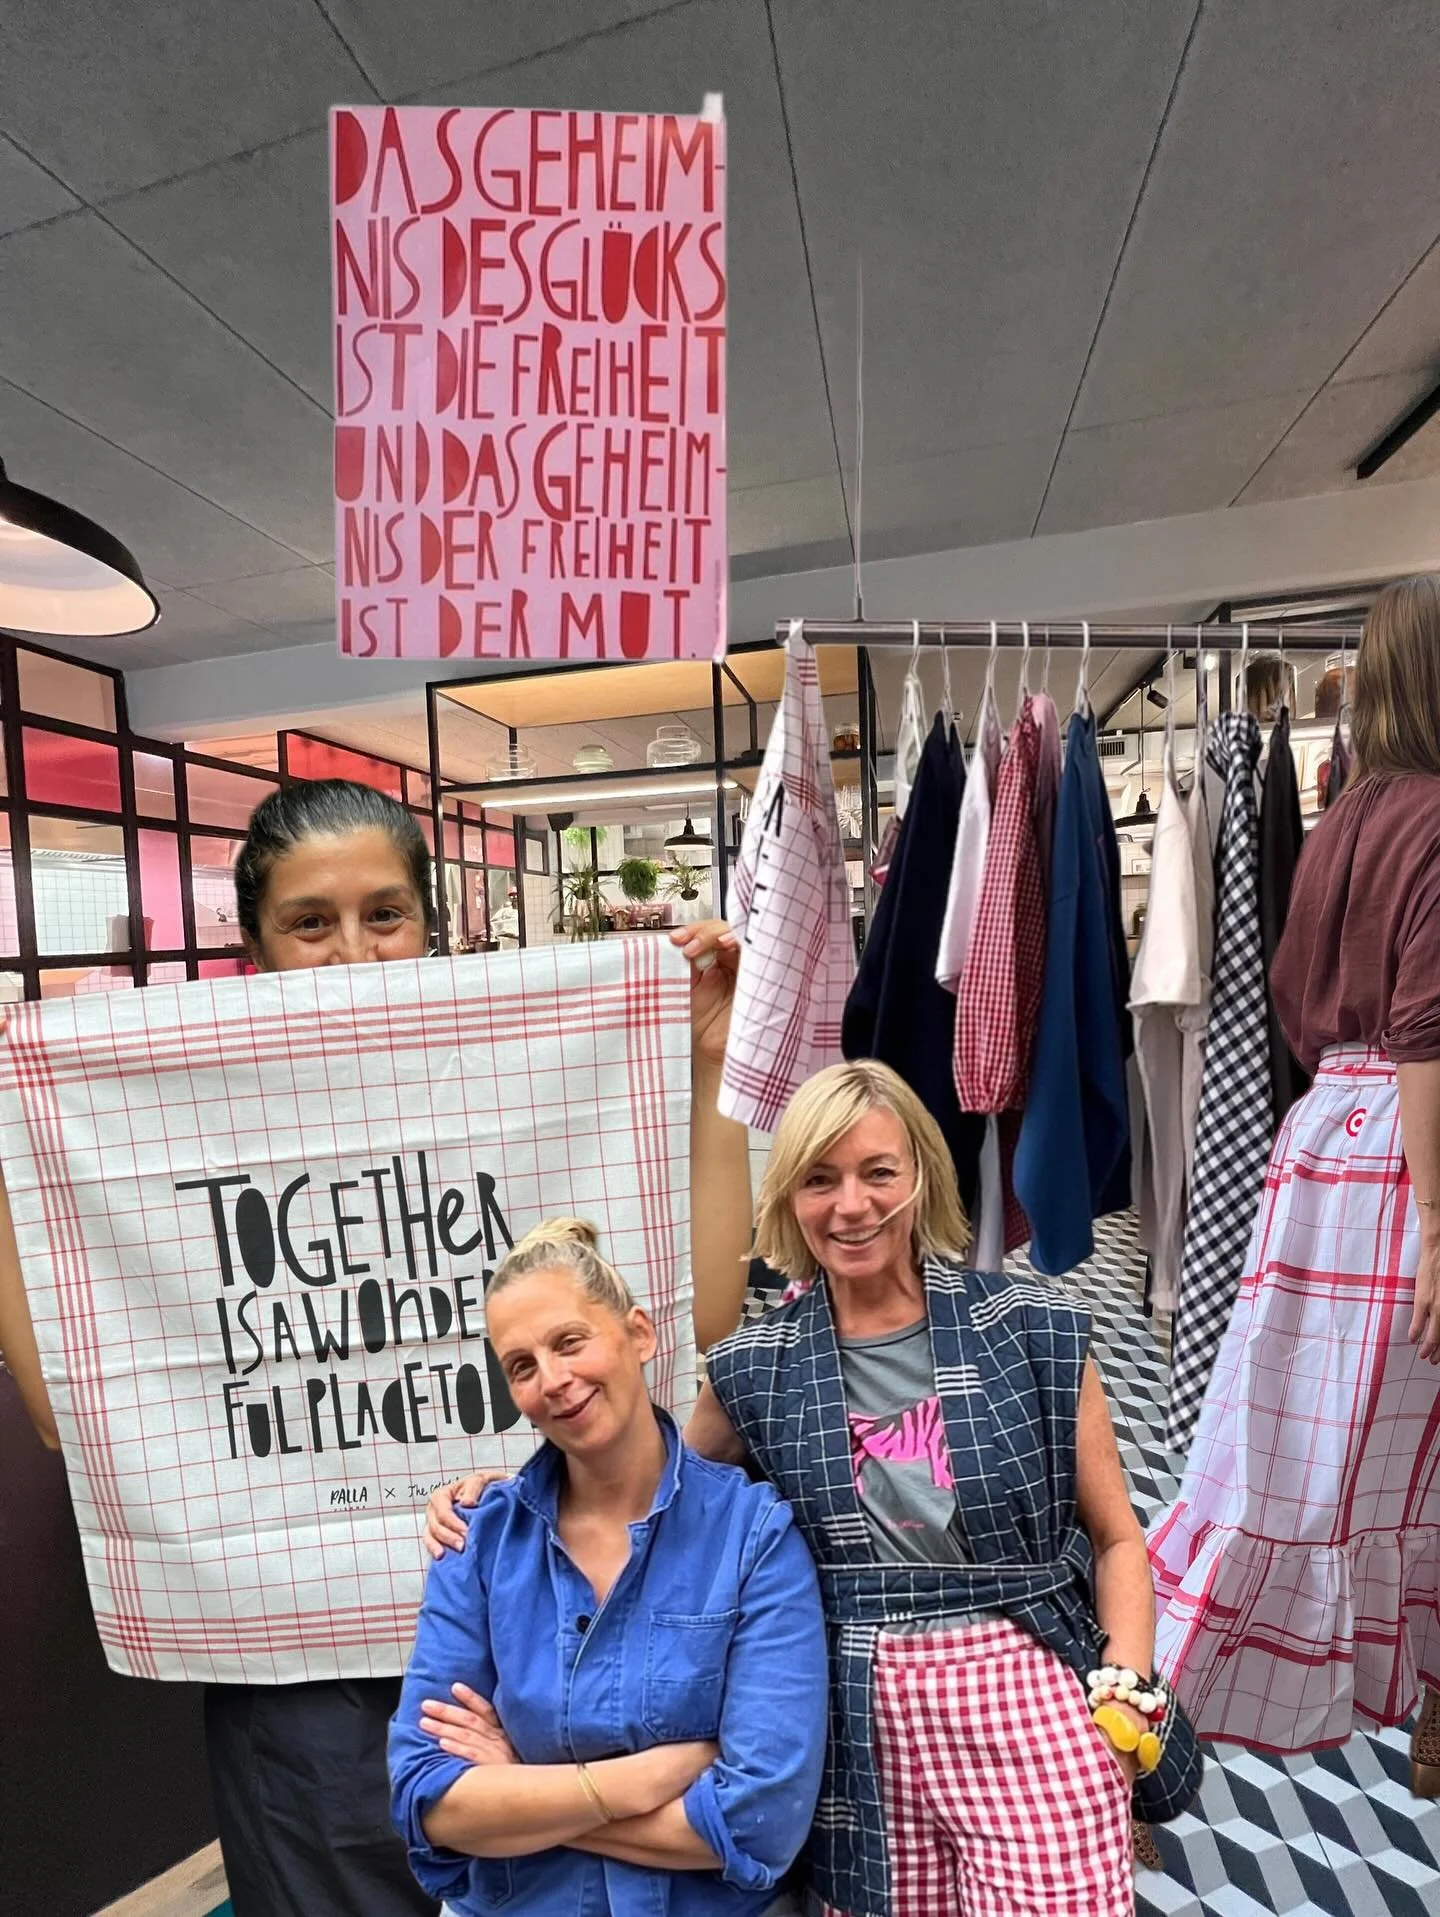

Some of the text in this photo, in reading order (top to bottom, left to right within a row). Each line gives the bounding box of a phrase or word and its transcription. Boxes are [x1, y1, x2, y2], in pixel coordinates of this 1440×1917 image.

[337, 217, 420, 320] NIS
[337, 321, 726, 425] IST DIE FREIHEIT
[335, 421, 430, 505] UND
[345, 507, 711, 590] NIS DER FREIHEIT
[341, 598, 408, 658] IST
[438, 589, 530, 659] DER
[560, 590, 697, 659] MUT.
[330, 1486, 368, 1505] PALLA
